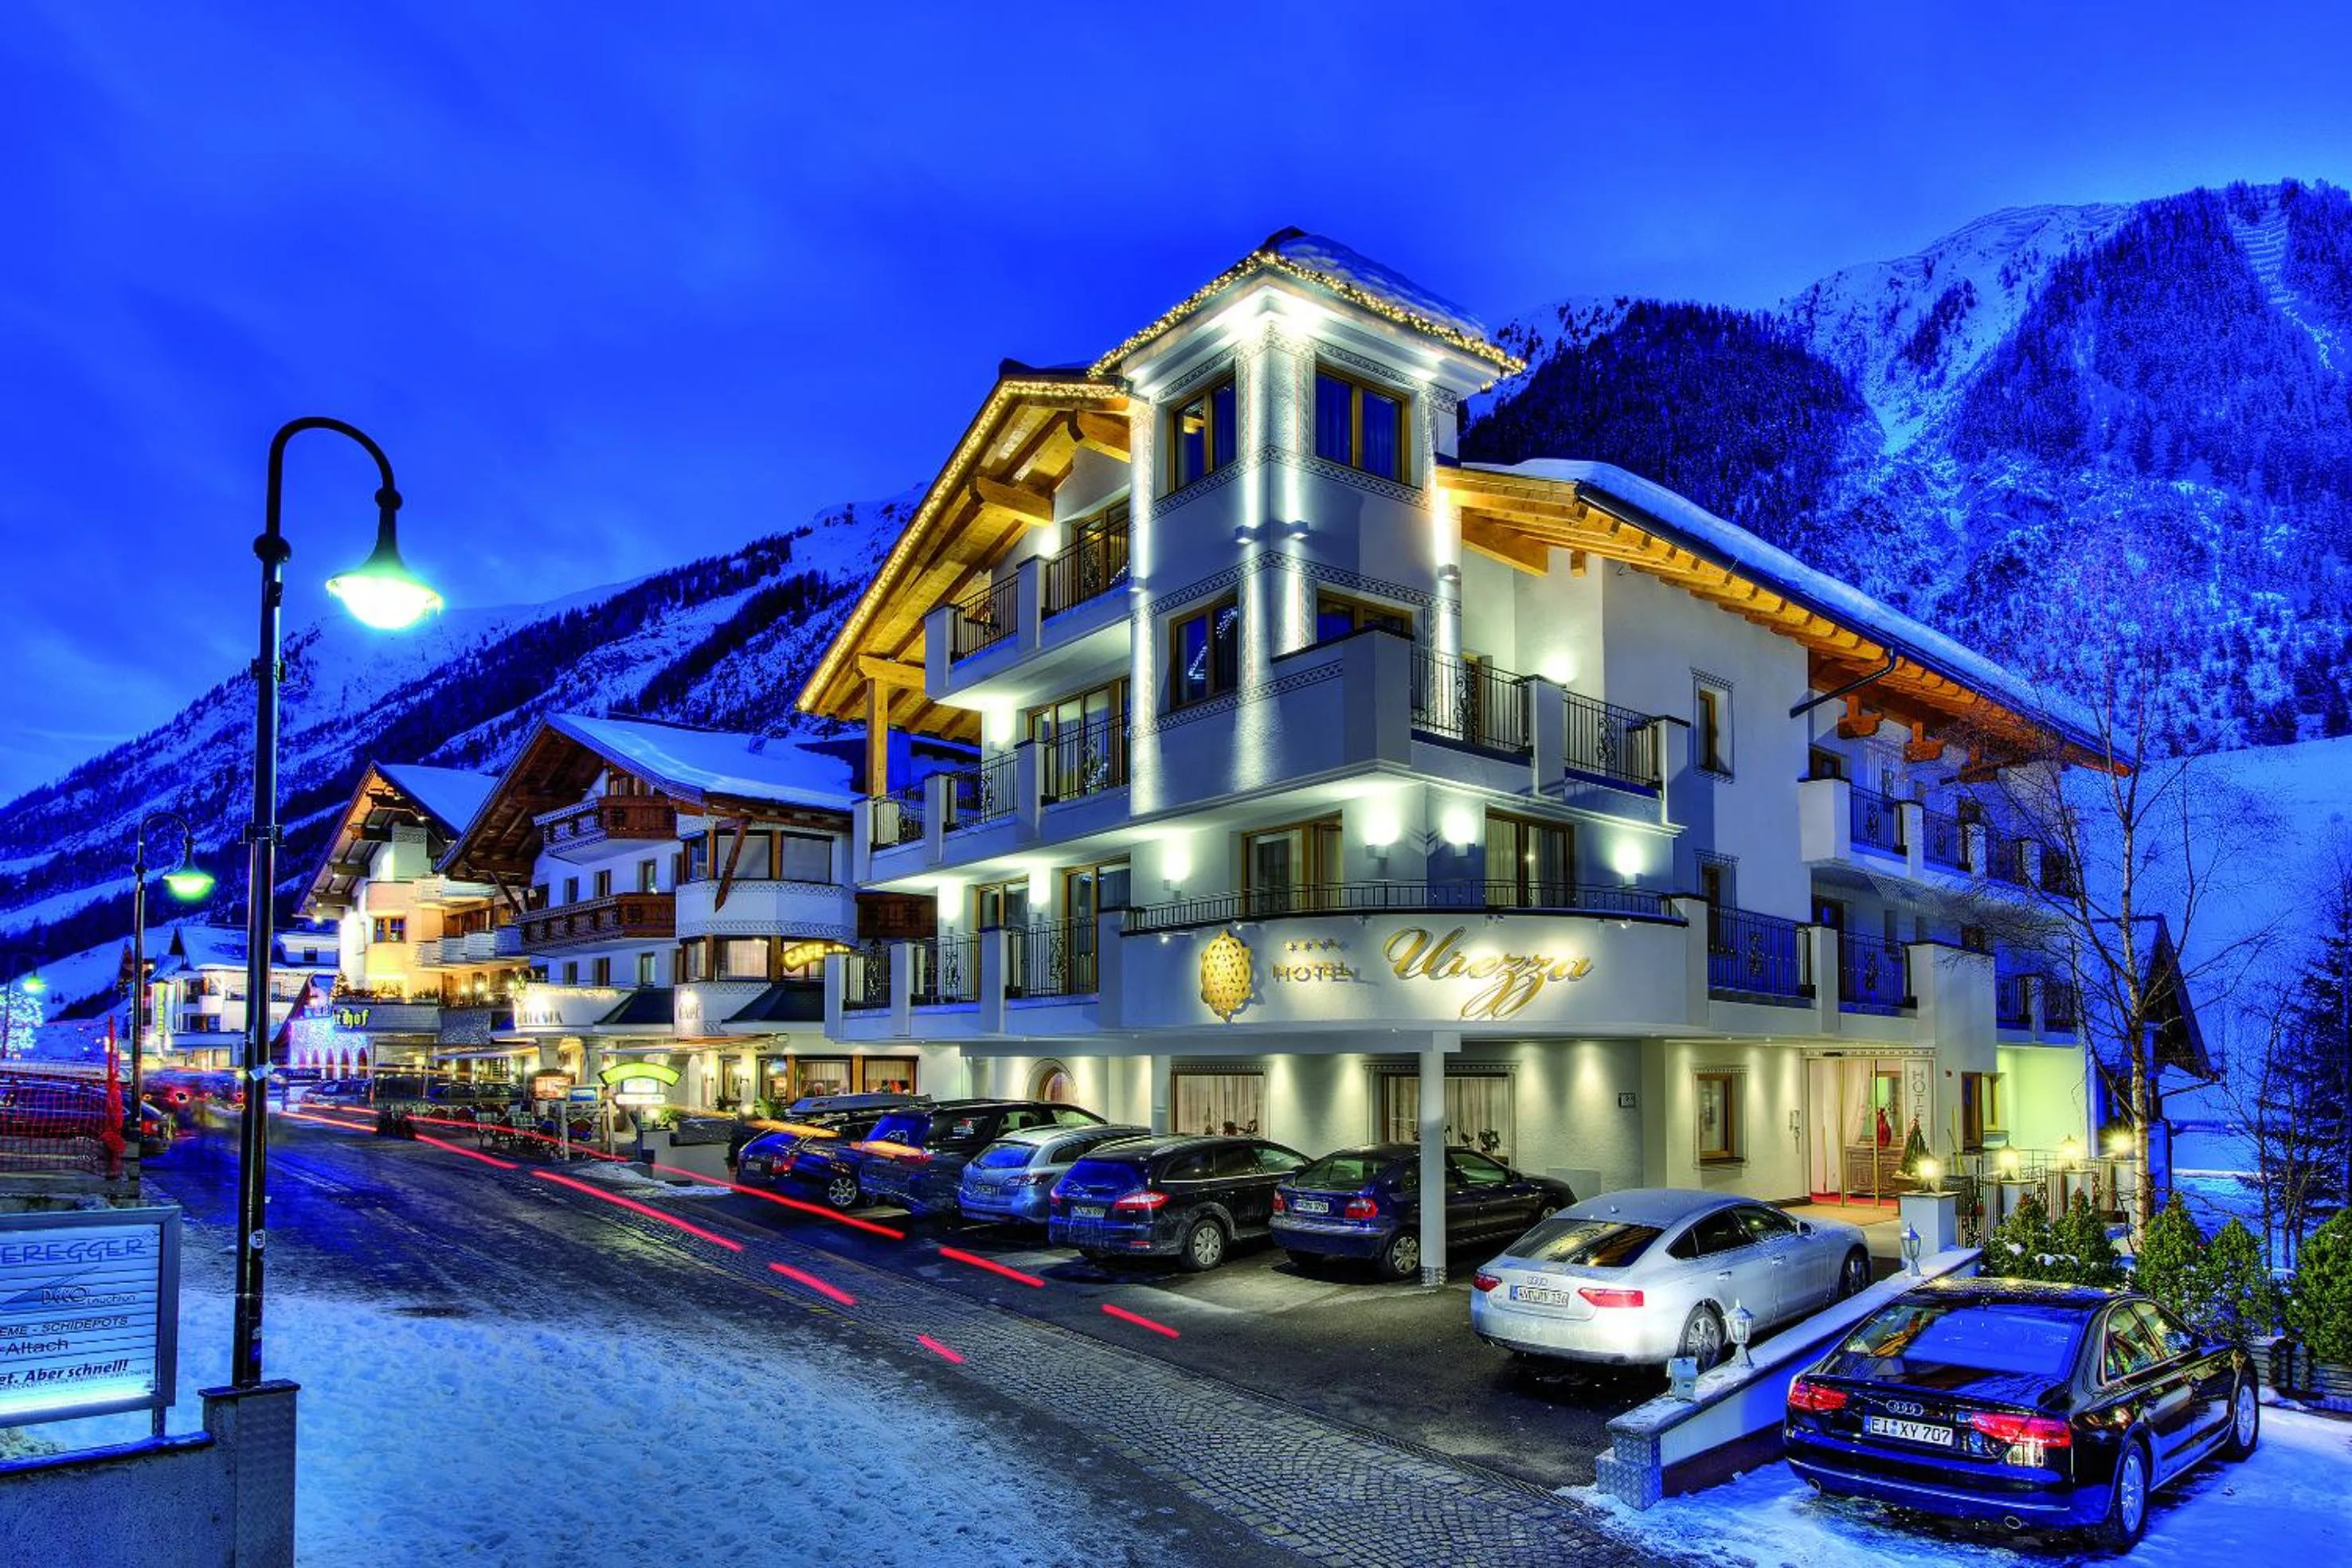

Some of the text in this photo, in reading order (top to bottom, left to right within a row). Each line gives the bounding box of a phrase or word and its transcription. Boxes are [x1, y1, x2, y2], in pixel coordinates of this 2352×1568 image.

[1272, 961, 1358, 981] HOTEL
[1912, 1069, 1927, 1116] HOTE
[42, 1316, 128, 1333] SCHIDEPOTS
[24, 1367, 65, 1382] Aber
[68, 1359, 129, 1378] schnell!
[1871, 1418, 1951, 1444] EI XY 707
